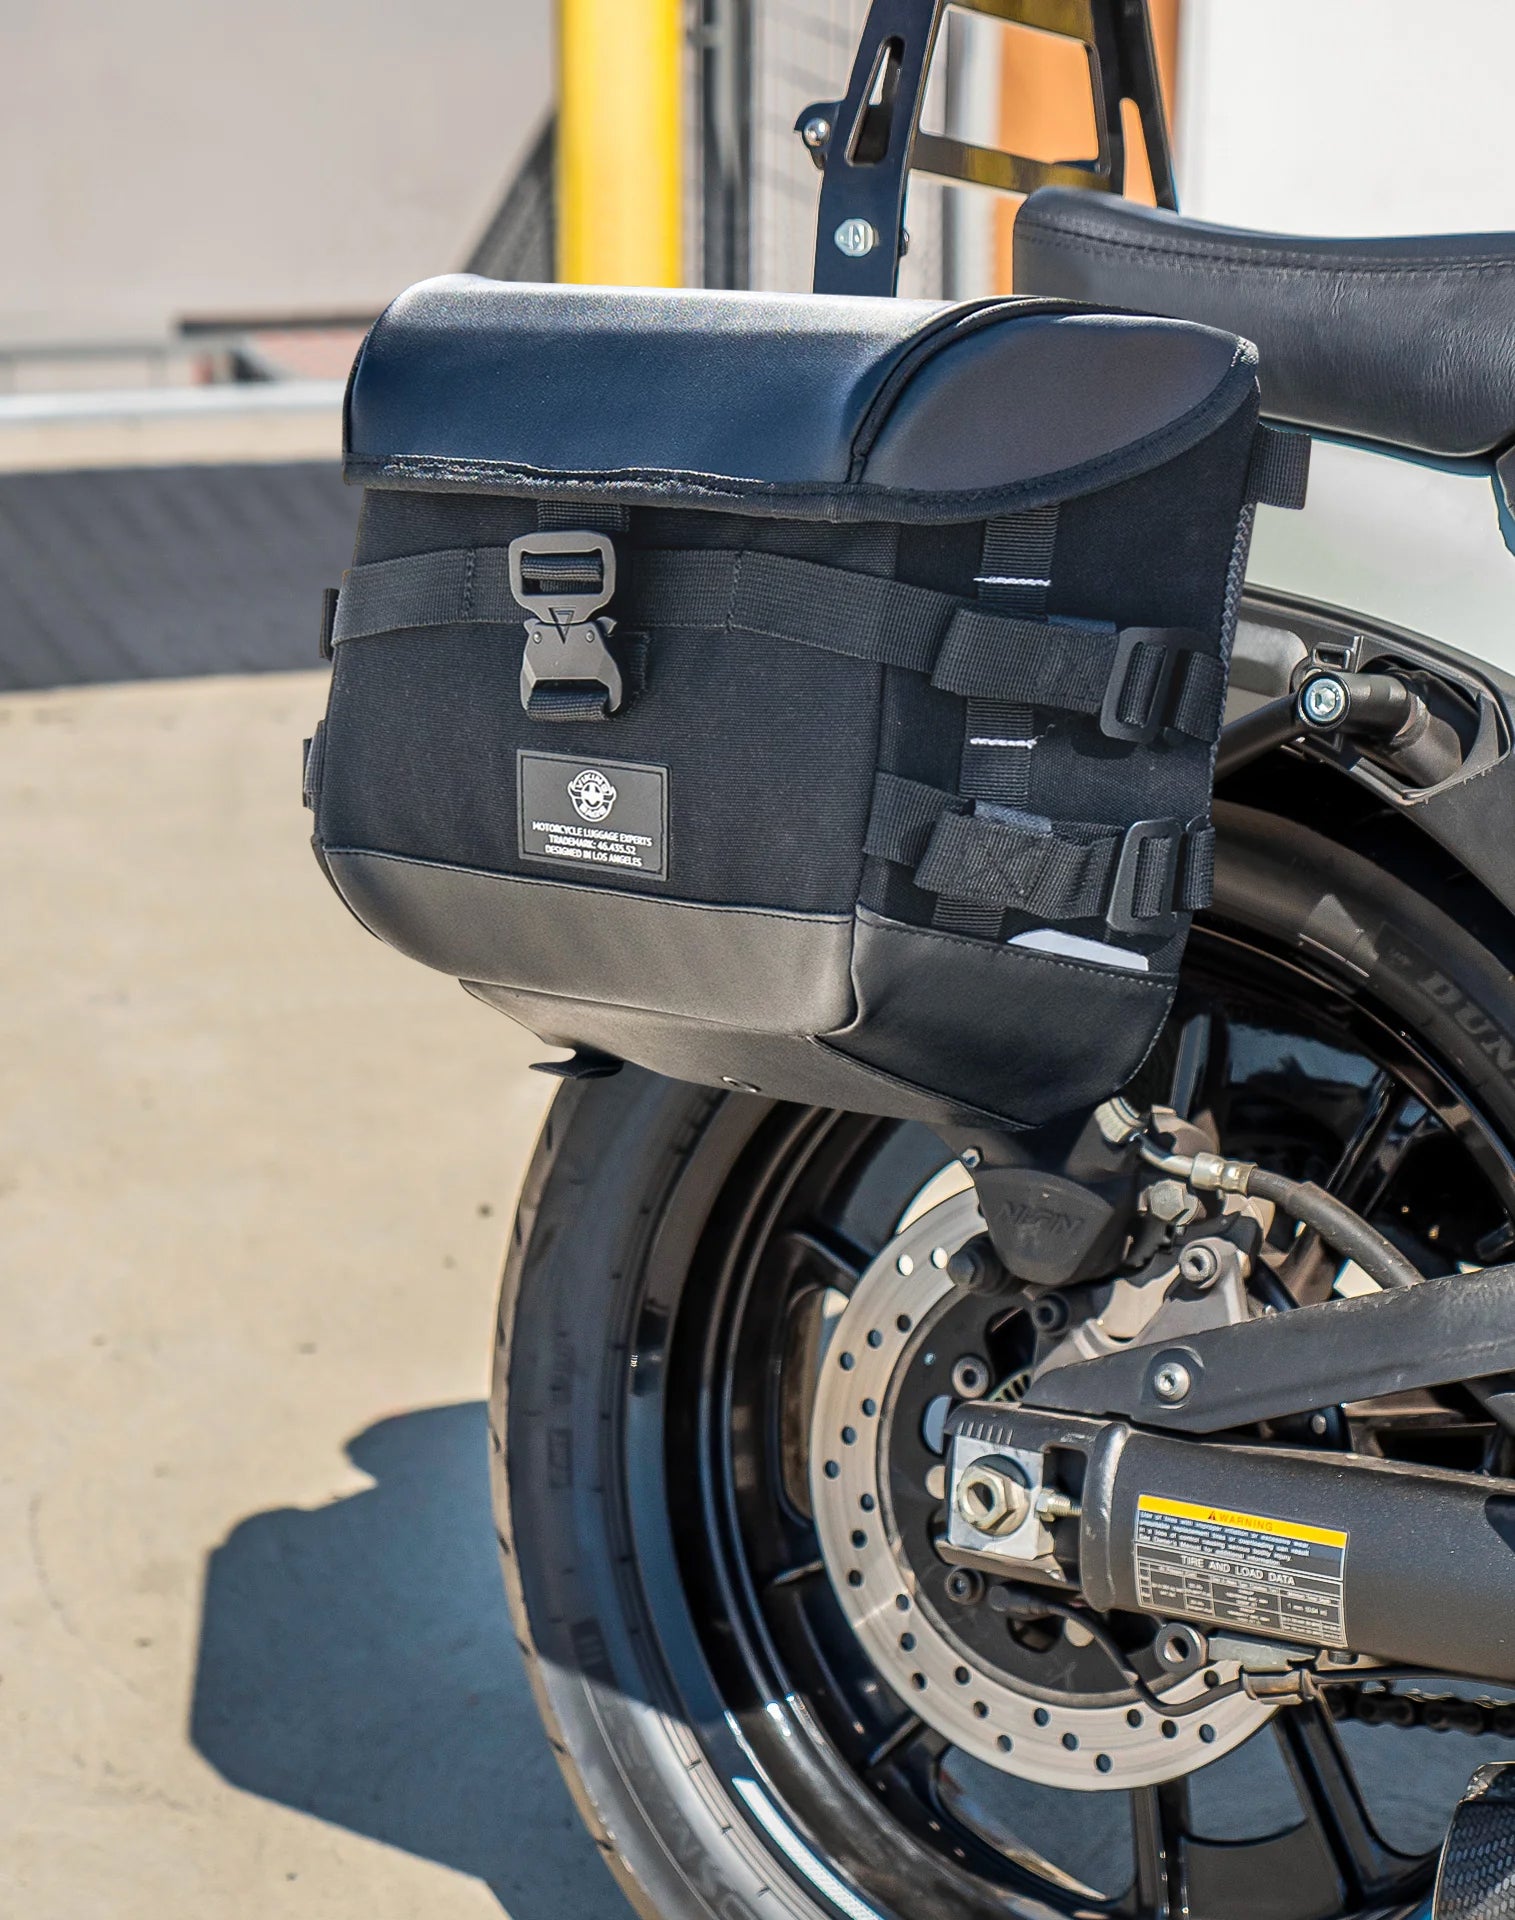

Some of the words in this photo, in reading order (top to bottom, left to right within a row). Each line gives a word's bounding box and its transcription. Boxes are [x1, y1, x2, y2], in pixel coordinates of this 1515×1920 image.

[575, 773, 612, 795] VIKING
[579, 804, 607, 818] BAGS
[532, 821, 583, 836] MOTORCYCLE
[583, 828, 619, 842] LUGGAGE
[619, 833, 653, 847] EXPERTS
[544, 844, 582, 858] DESIGNED
[582, 849, 591, 860] IN
[592, 850, 608, 862] LOS
[608, 853, 643, 867] ANGELES
[1413, 970, 1515, 1090] DUN
[1220, 1513, 1273, 1532] WARNING
[1181, 1555, 1205, 1569] TIRE
[1208, 1560, 1231, 1574] AND
[1234, 1565, 1264, 1580] LOAD
[1267, 1572, 1295, 1586] DATA
